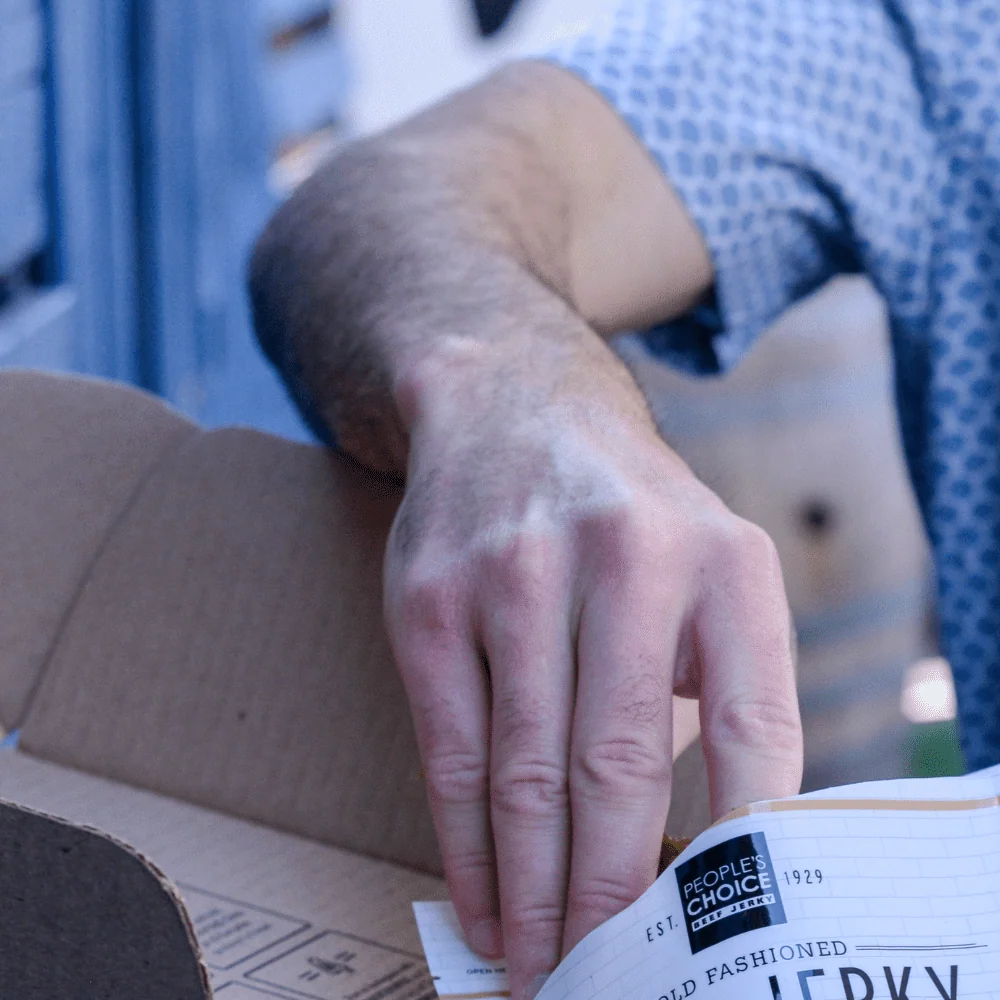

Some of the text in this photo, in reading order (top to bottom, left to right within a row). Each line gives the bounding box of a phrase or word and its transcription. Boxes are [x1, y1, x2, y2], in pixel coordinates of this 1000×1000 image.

[683, 854, 767, 899] PEOPLE'S
[686, 872, 772, 916] CHOICE
[646, 869, 823, 942] EST. 1929
[693, 895, 773, 930] BEEF JERKY
[705, 940, 848, 986] FASHIONED
